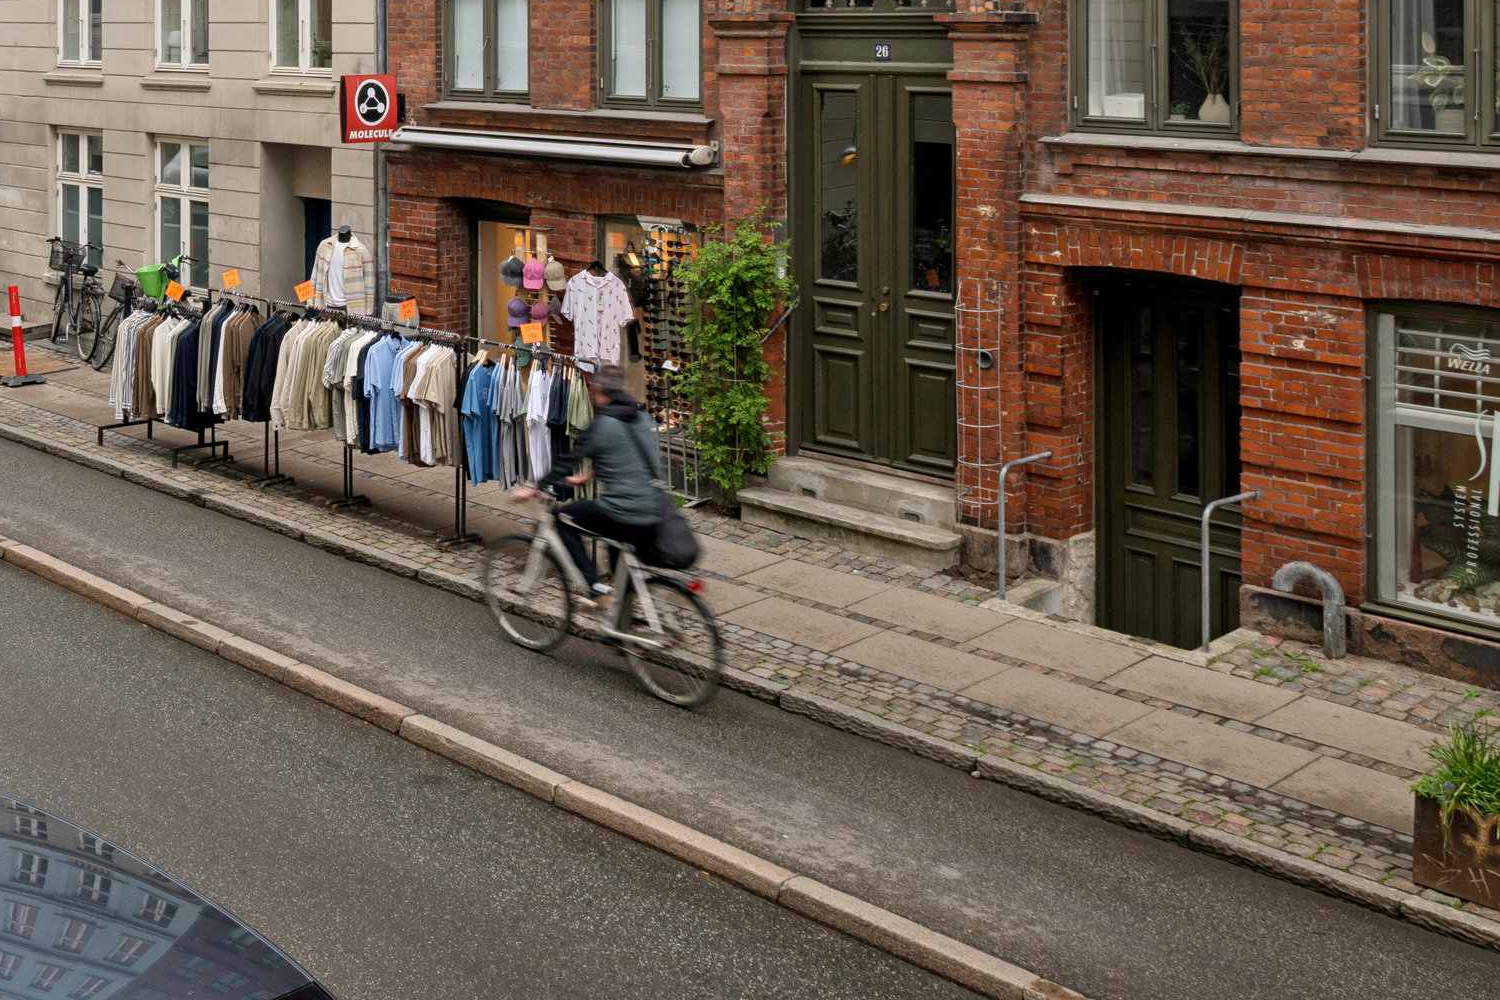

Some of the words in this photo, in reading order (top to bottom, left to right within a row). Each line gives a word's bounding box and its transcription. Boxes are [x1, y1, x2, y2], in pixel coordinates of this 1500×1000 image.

[875, 45, 889, 58] 26
[349, 129, 394, 140] MOLECULE
[1448, 358, 1490, 374] WELLA
[1453, 485, 1467, 528] SYSTEM
[1466, 489, 1482, 575] PROFESSIONAL
